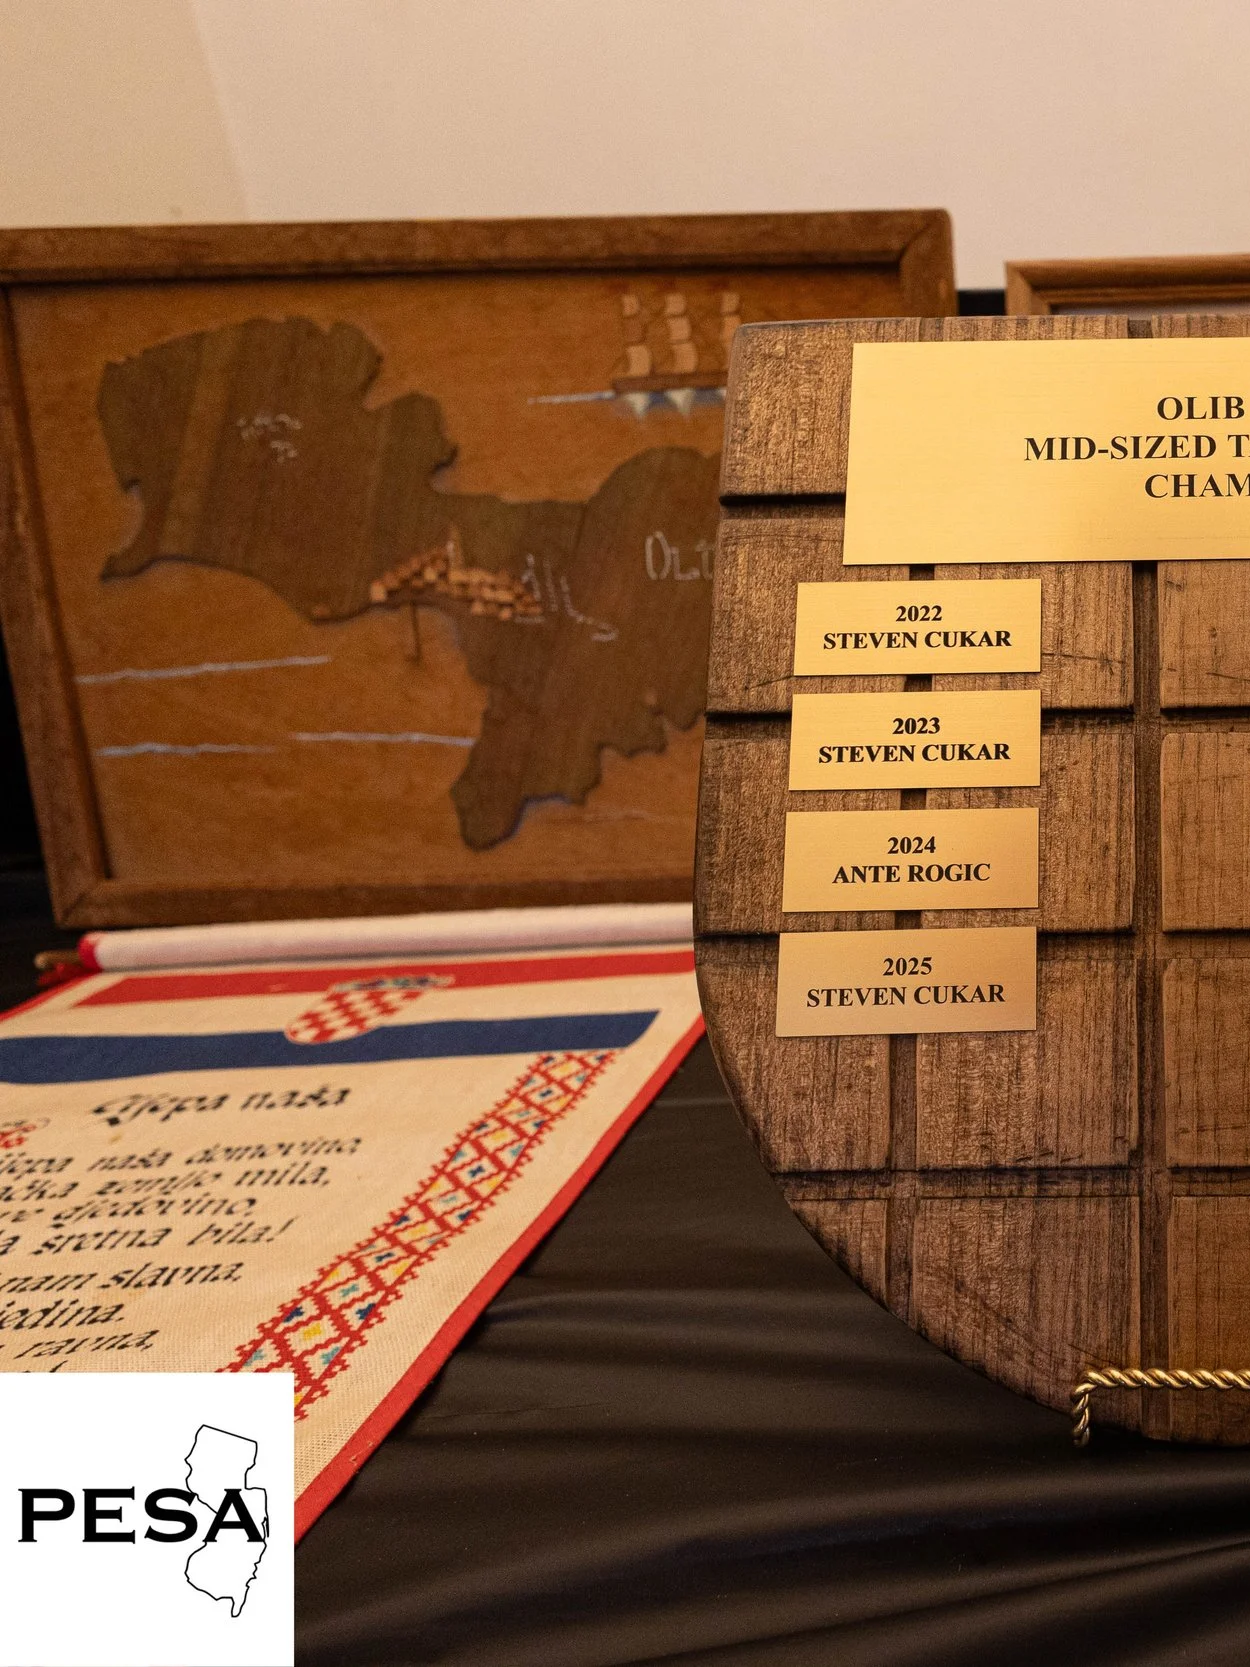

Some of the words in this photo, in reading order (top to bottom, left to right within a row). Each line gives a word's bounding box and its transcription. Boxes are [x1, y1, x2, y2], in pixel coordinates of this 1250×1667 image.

[1156, 395, 1246, 421] OLIB
[1023, 434, 1218, 461] MID-SIZED
[895, 605, 943, 622] 2022
[823, 632, 918, 650] STEVEN
[924, 630, 1012, 648] CUKAR
[892, 717, 941, 735] 2023
[818, 745, 915, 764] STEVEN
[921, 743, 1011, 761] CUKAR
[887, 836, 936, 854] 2024
[832, 865, 900, 884] ANTE
[907, 863, 991, 883] ROGIC
[882, 956, 933, 976] 2025
[806, 986, 906, 1008] STEVEN
[913, 984, 1006, 1005] CUKAR
